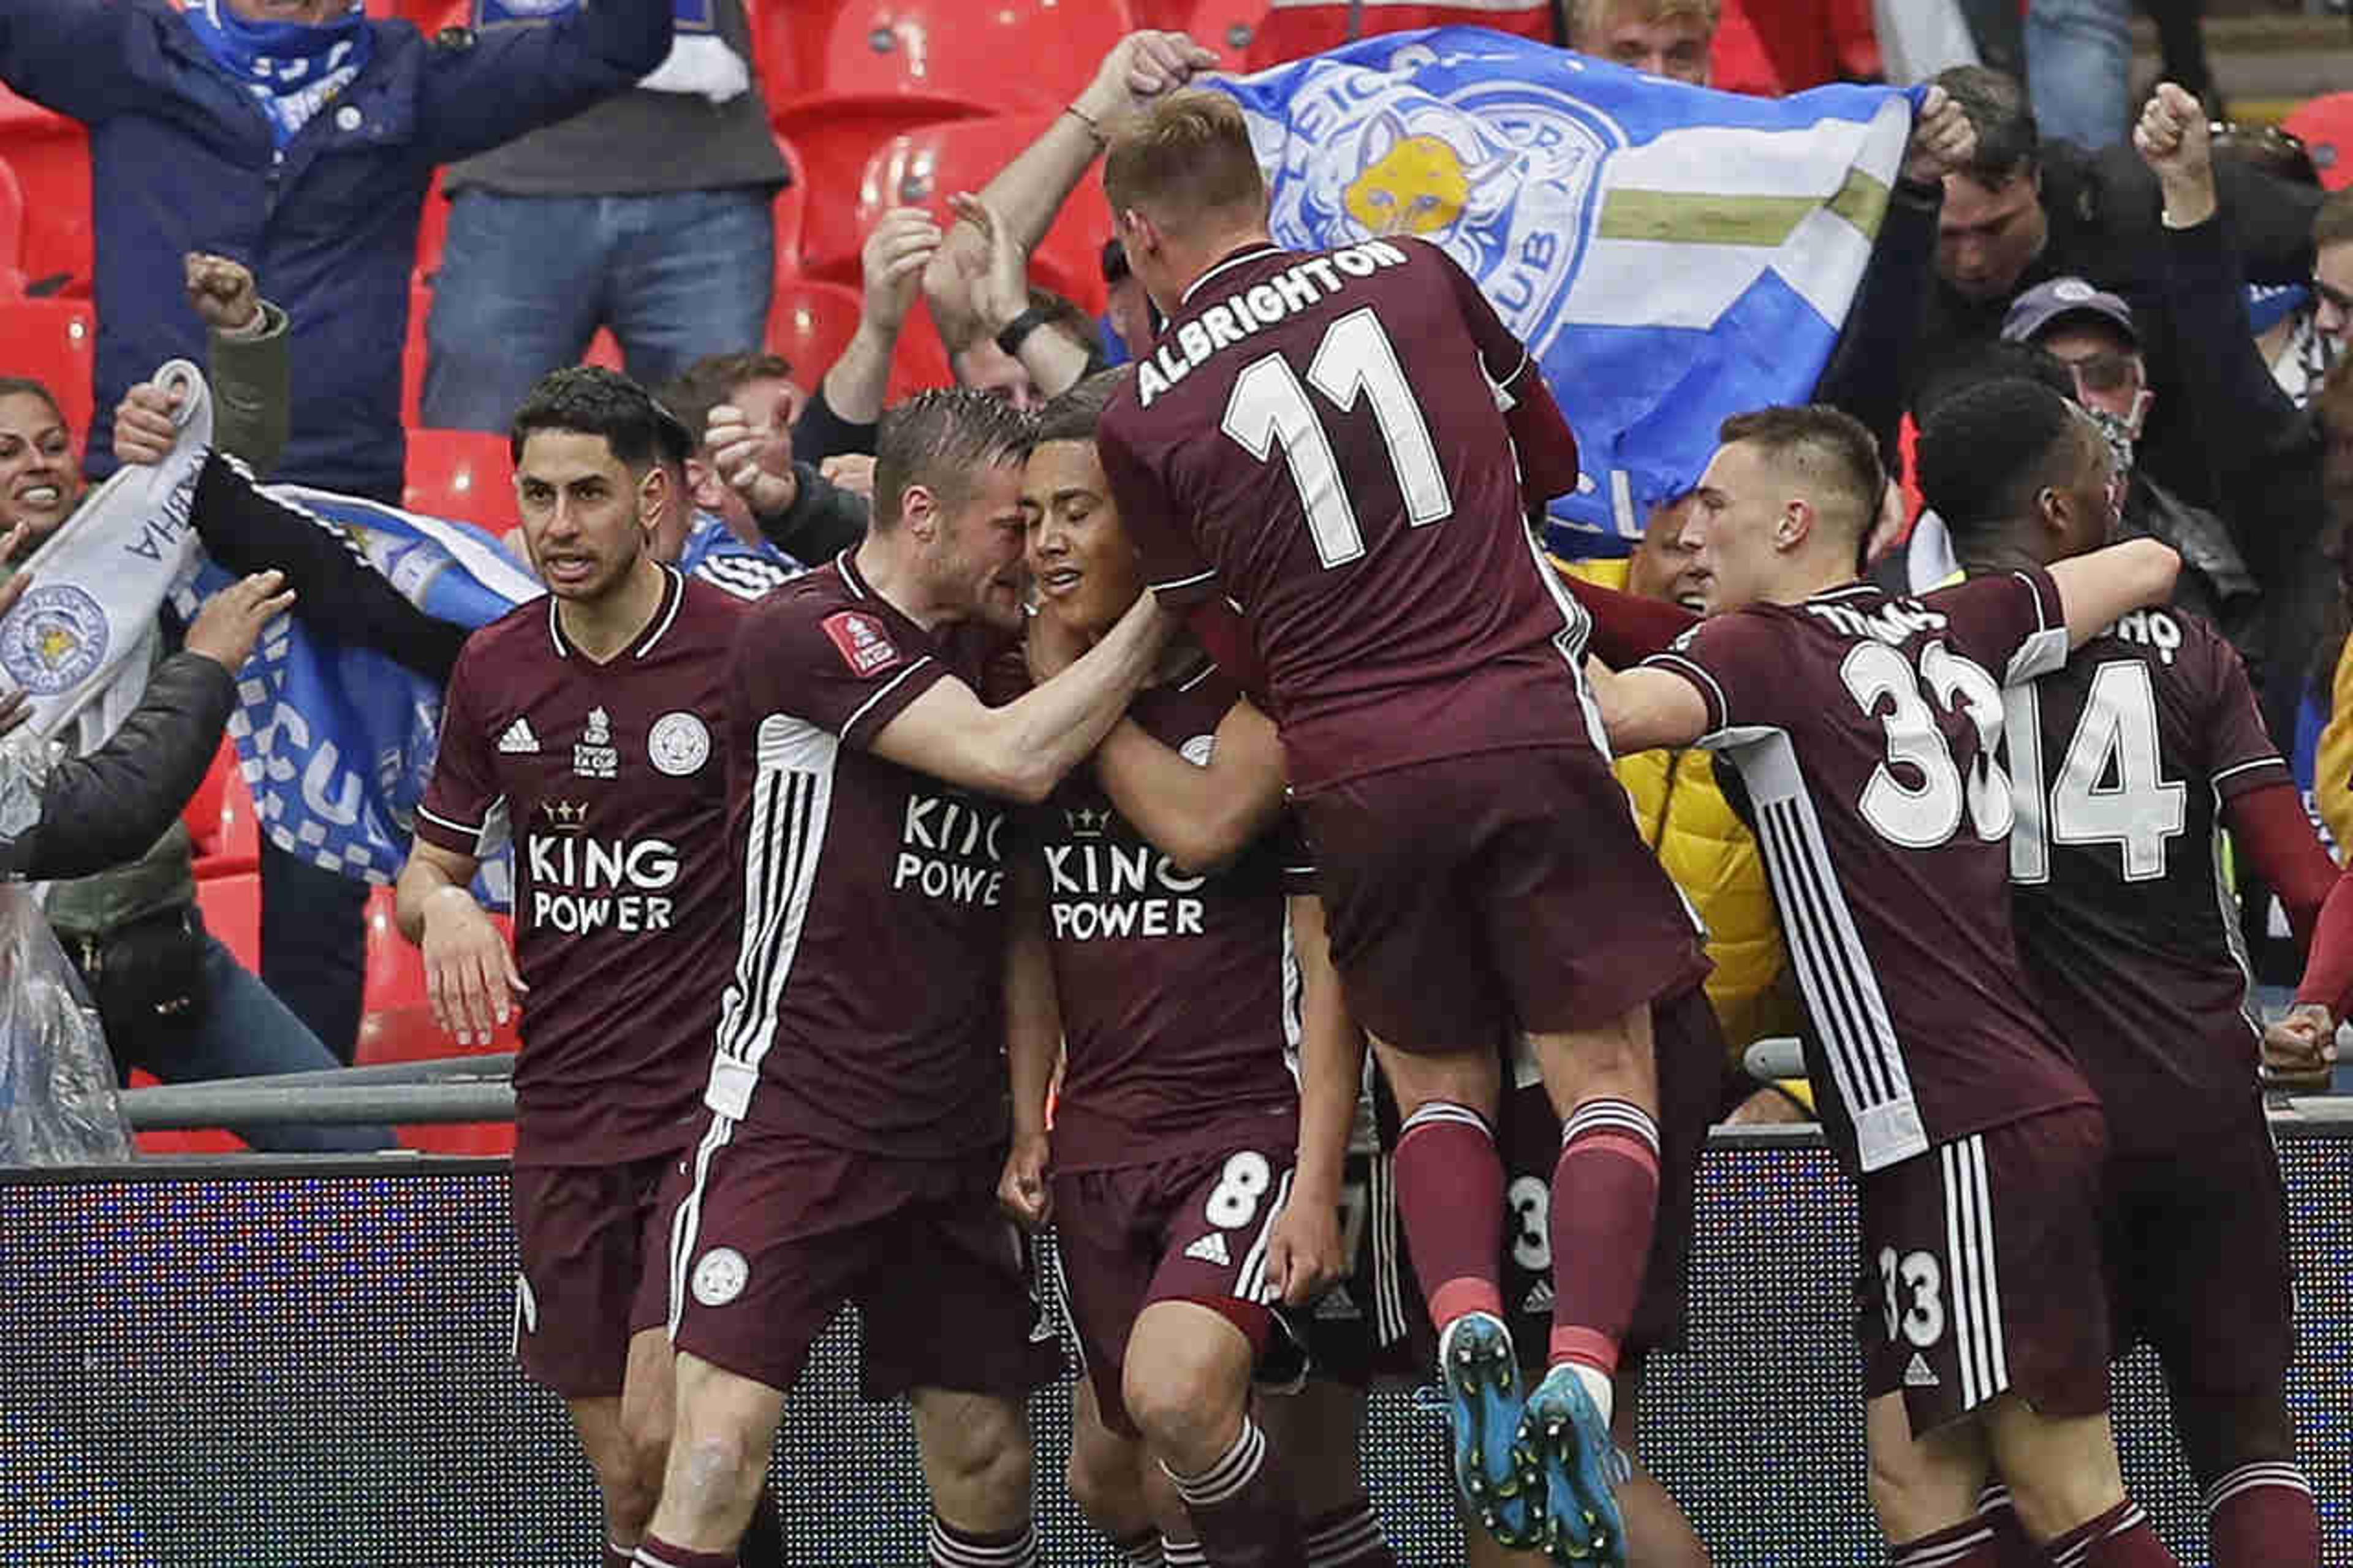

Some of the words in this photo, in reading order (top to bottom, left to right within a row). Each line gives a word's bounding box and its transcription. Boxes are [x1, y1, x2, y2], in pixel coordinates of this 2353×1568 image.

[1138, 239, 1408, 407] ALBRIGHTON
[1221, 307, 1453, 569] 11
[529, 833, 678, 889] KING
[533, 891, 673, 935] POWER
[1051, 899, 1205, 941] POWER
[1205, 1150, 1270, 1229] 8
